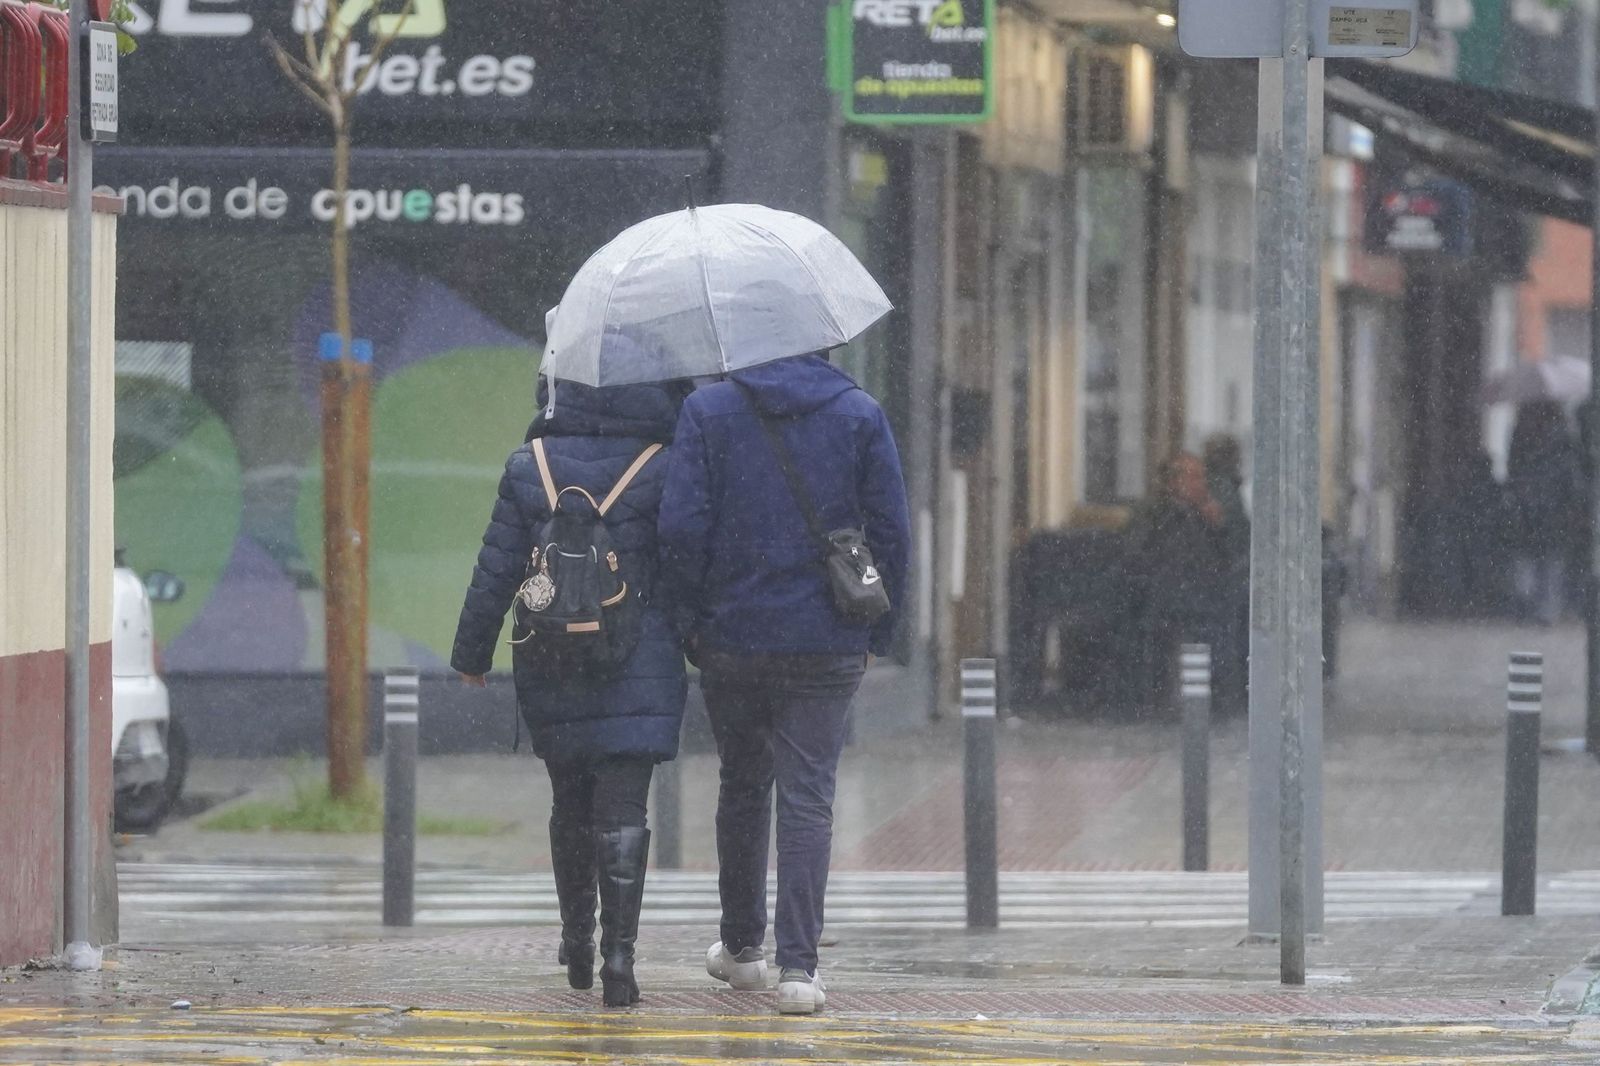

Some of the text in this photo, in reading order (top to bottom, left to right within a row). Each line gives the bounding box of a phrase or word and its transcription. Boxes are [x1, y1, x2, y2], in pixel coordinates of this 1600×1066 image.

[340, 41, 535, 96] bet.es
[882, 60, 952, 78] tienda
[224, 177, 288, 220] de
[311, 184, 525, 228] apuestas
